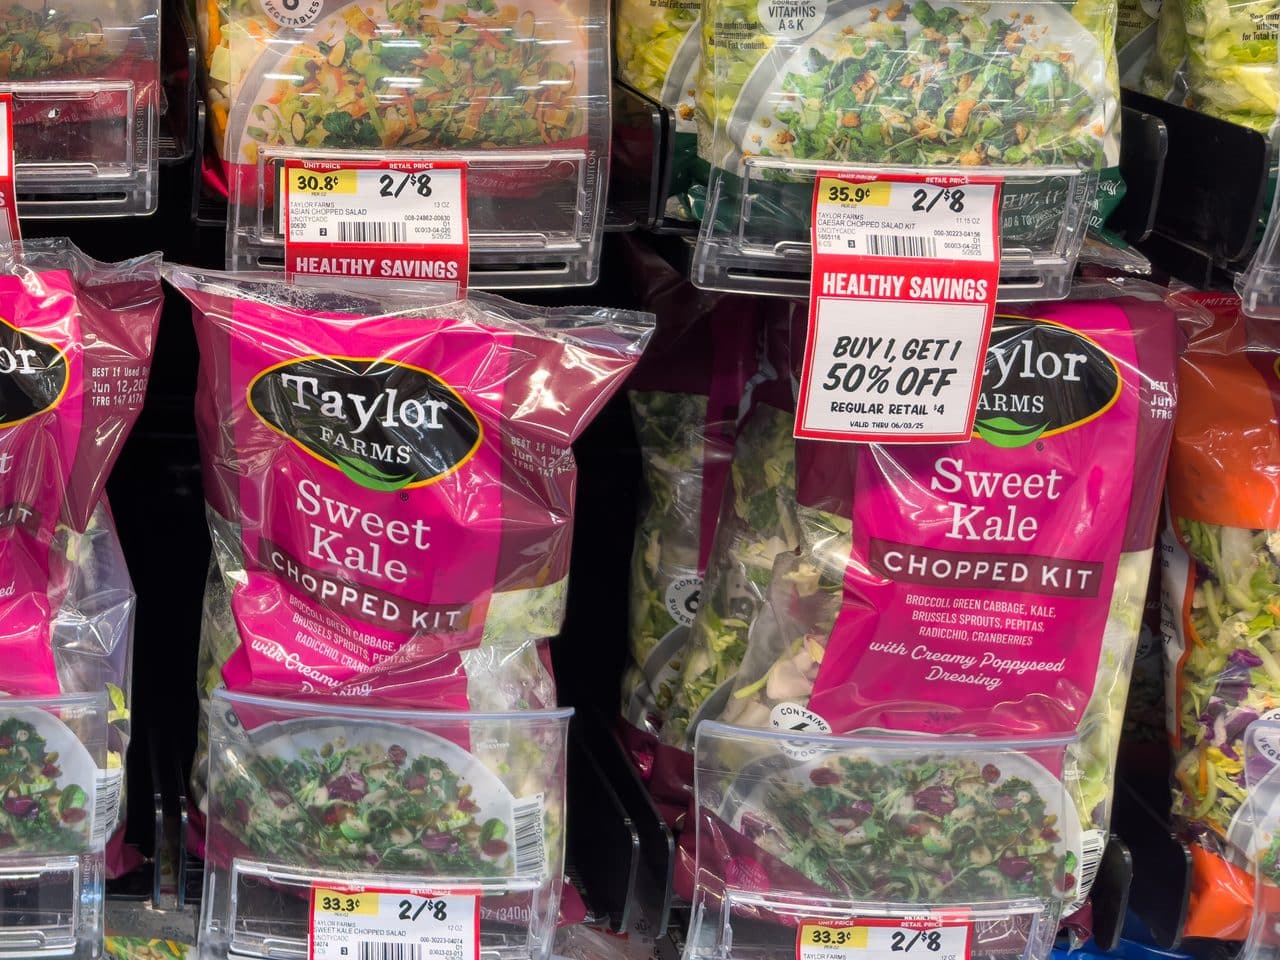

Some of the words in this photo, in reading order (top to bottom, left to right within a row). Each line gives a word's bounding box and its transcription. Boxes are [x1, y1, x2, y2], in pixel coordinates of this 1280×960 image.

[297, 175, 339, 191] 30.8¢
[379, 174, 432, 198] 2/$8
[829, 187, 871, 202] 35.9¢
[912, 188, 965, 213] 2/$8
[296, 257, 374, 276] HEALTHY
[381, 260, 458, 278] SAVINGS
[823, 272, 905, 297] HEALTHY
[909, 276, 987, 300] SAVINGS
[832, 336, 884, 360] BUY
[884, 338, 897, 364] 1,
[902, 339, 952, 360] GET
[951, 340, 962, 360] 1
[823, 364, 892, 394] 50%
[895, 367, 957, 398] OFF
[280, 373, 449, 433] Taylor
[320, 427, 412, 464] FARMS
[931, 457, 1062, 499] Sweet
[296, 479, 431, 550] Sweet
[945, 502, 1038, 542] Kale
[308, 524, 408, 583] Kale
[883, 552, 1028, 584] CHOPPED
[1041, 567, 1093, 589] KIT
[271, 551, 400, 621] CHOPPED
[411, 607, 461, 628] KIT
[919, 626, 969, 642] RADICCHIO,
[972, 631, 1033, 647] CRANBERRIES
[322, 896, 360, 911] 33.3¢
[398, 900, 448, 922] 2/$8
[811, 930, 852, 945] 33.3¢
[891, 930, 941, 952] 2/$8
